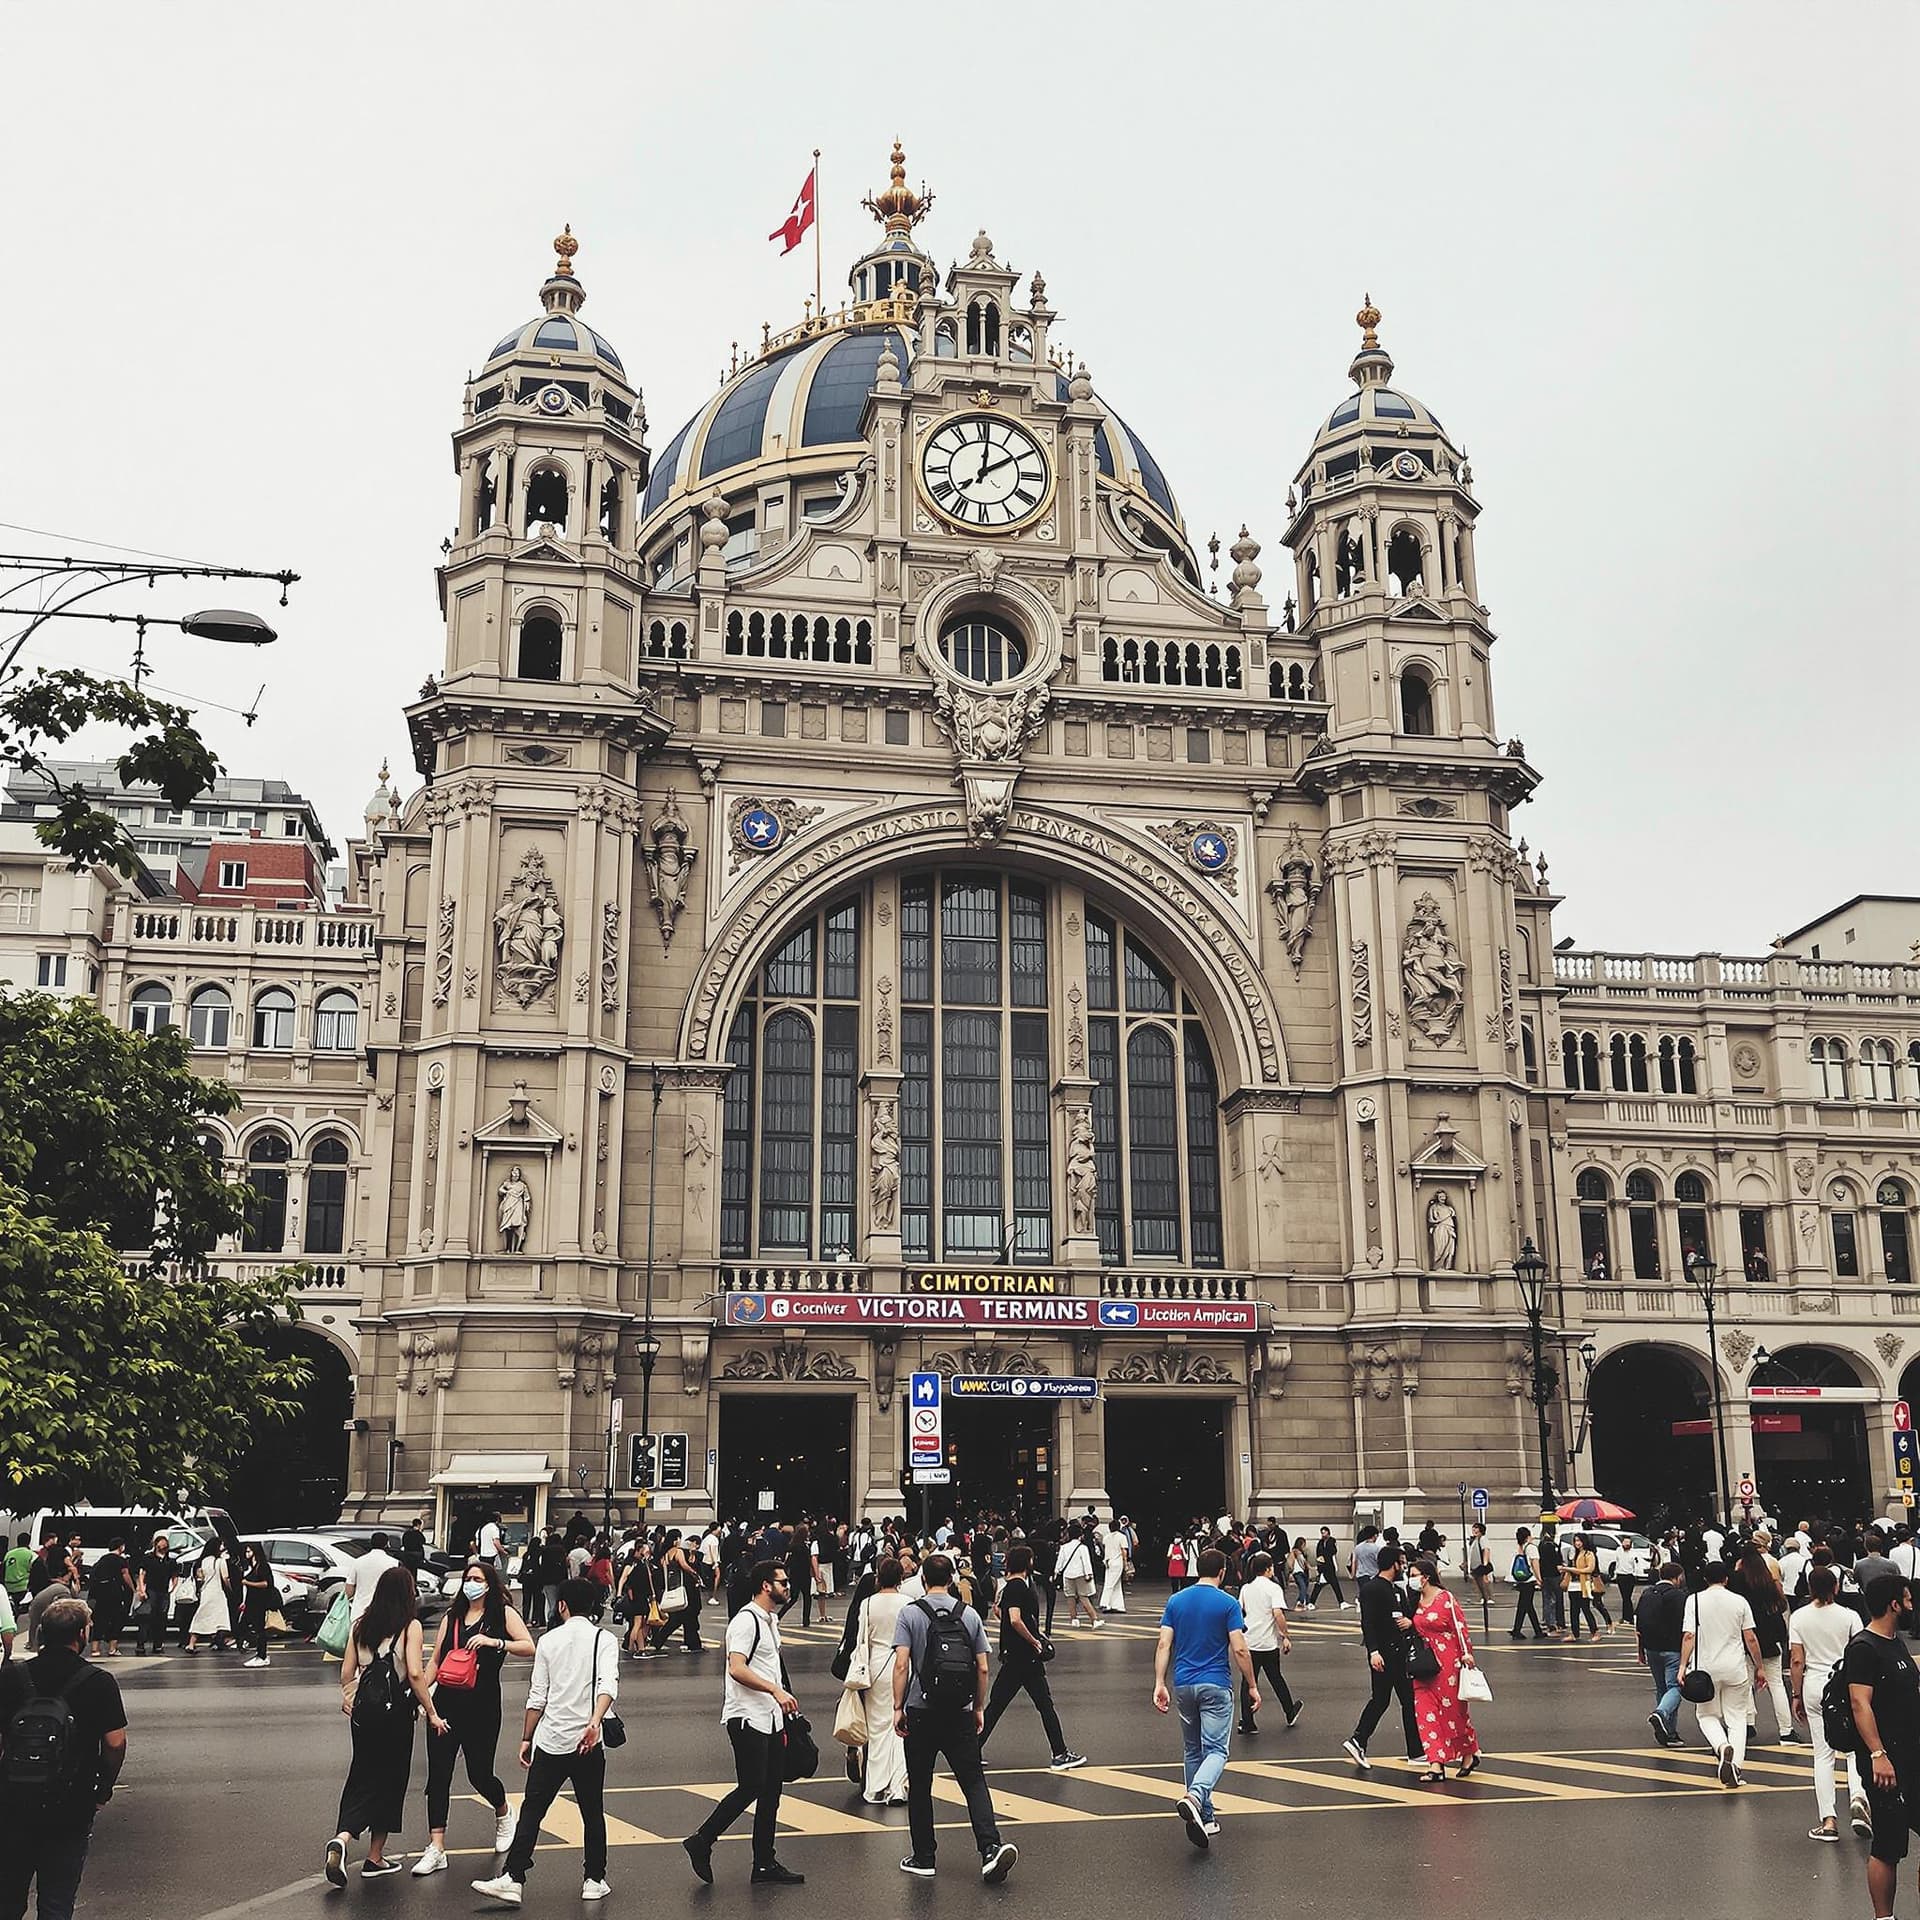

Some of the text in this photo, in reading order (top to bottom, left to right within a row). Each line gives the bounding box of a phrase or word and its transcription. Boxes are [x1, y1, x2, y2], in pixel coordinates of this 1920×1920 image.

[920, 1274, 1055, 1294] CIMTOTRIAN
[857, 1297, 966, 1319] VICTORIA
[980, 1299, 1089, 1321] TERMANS
